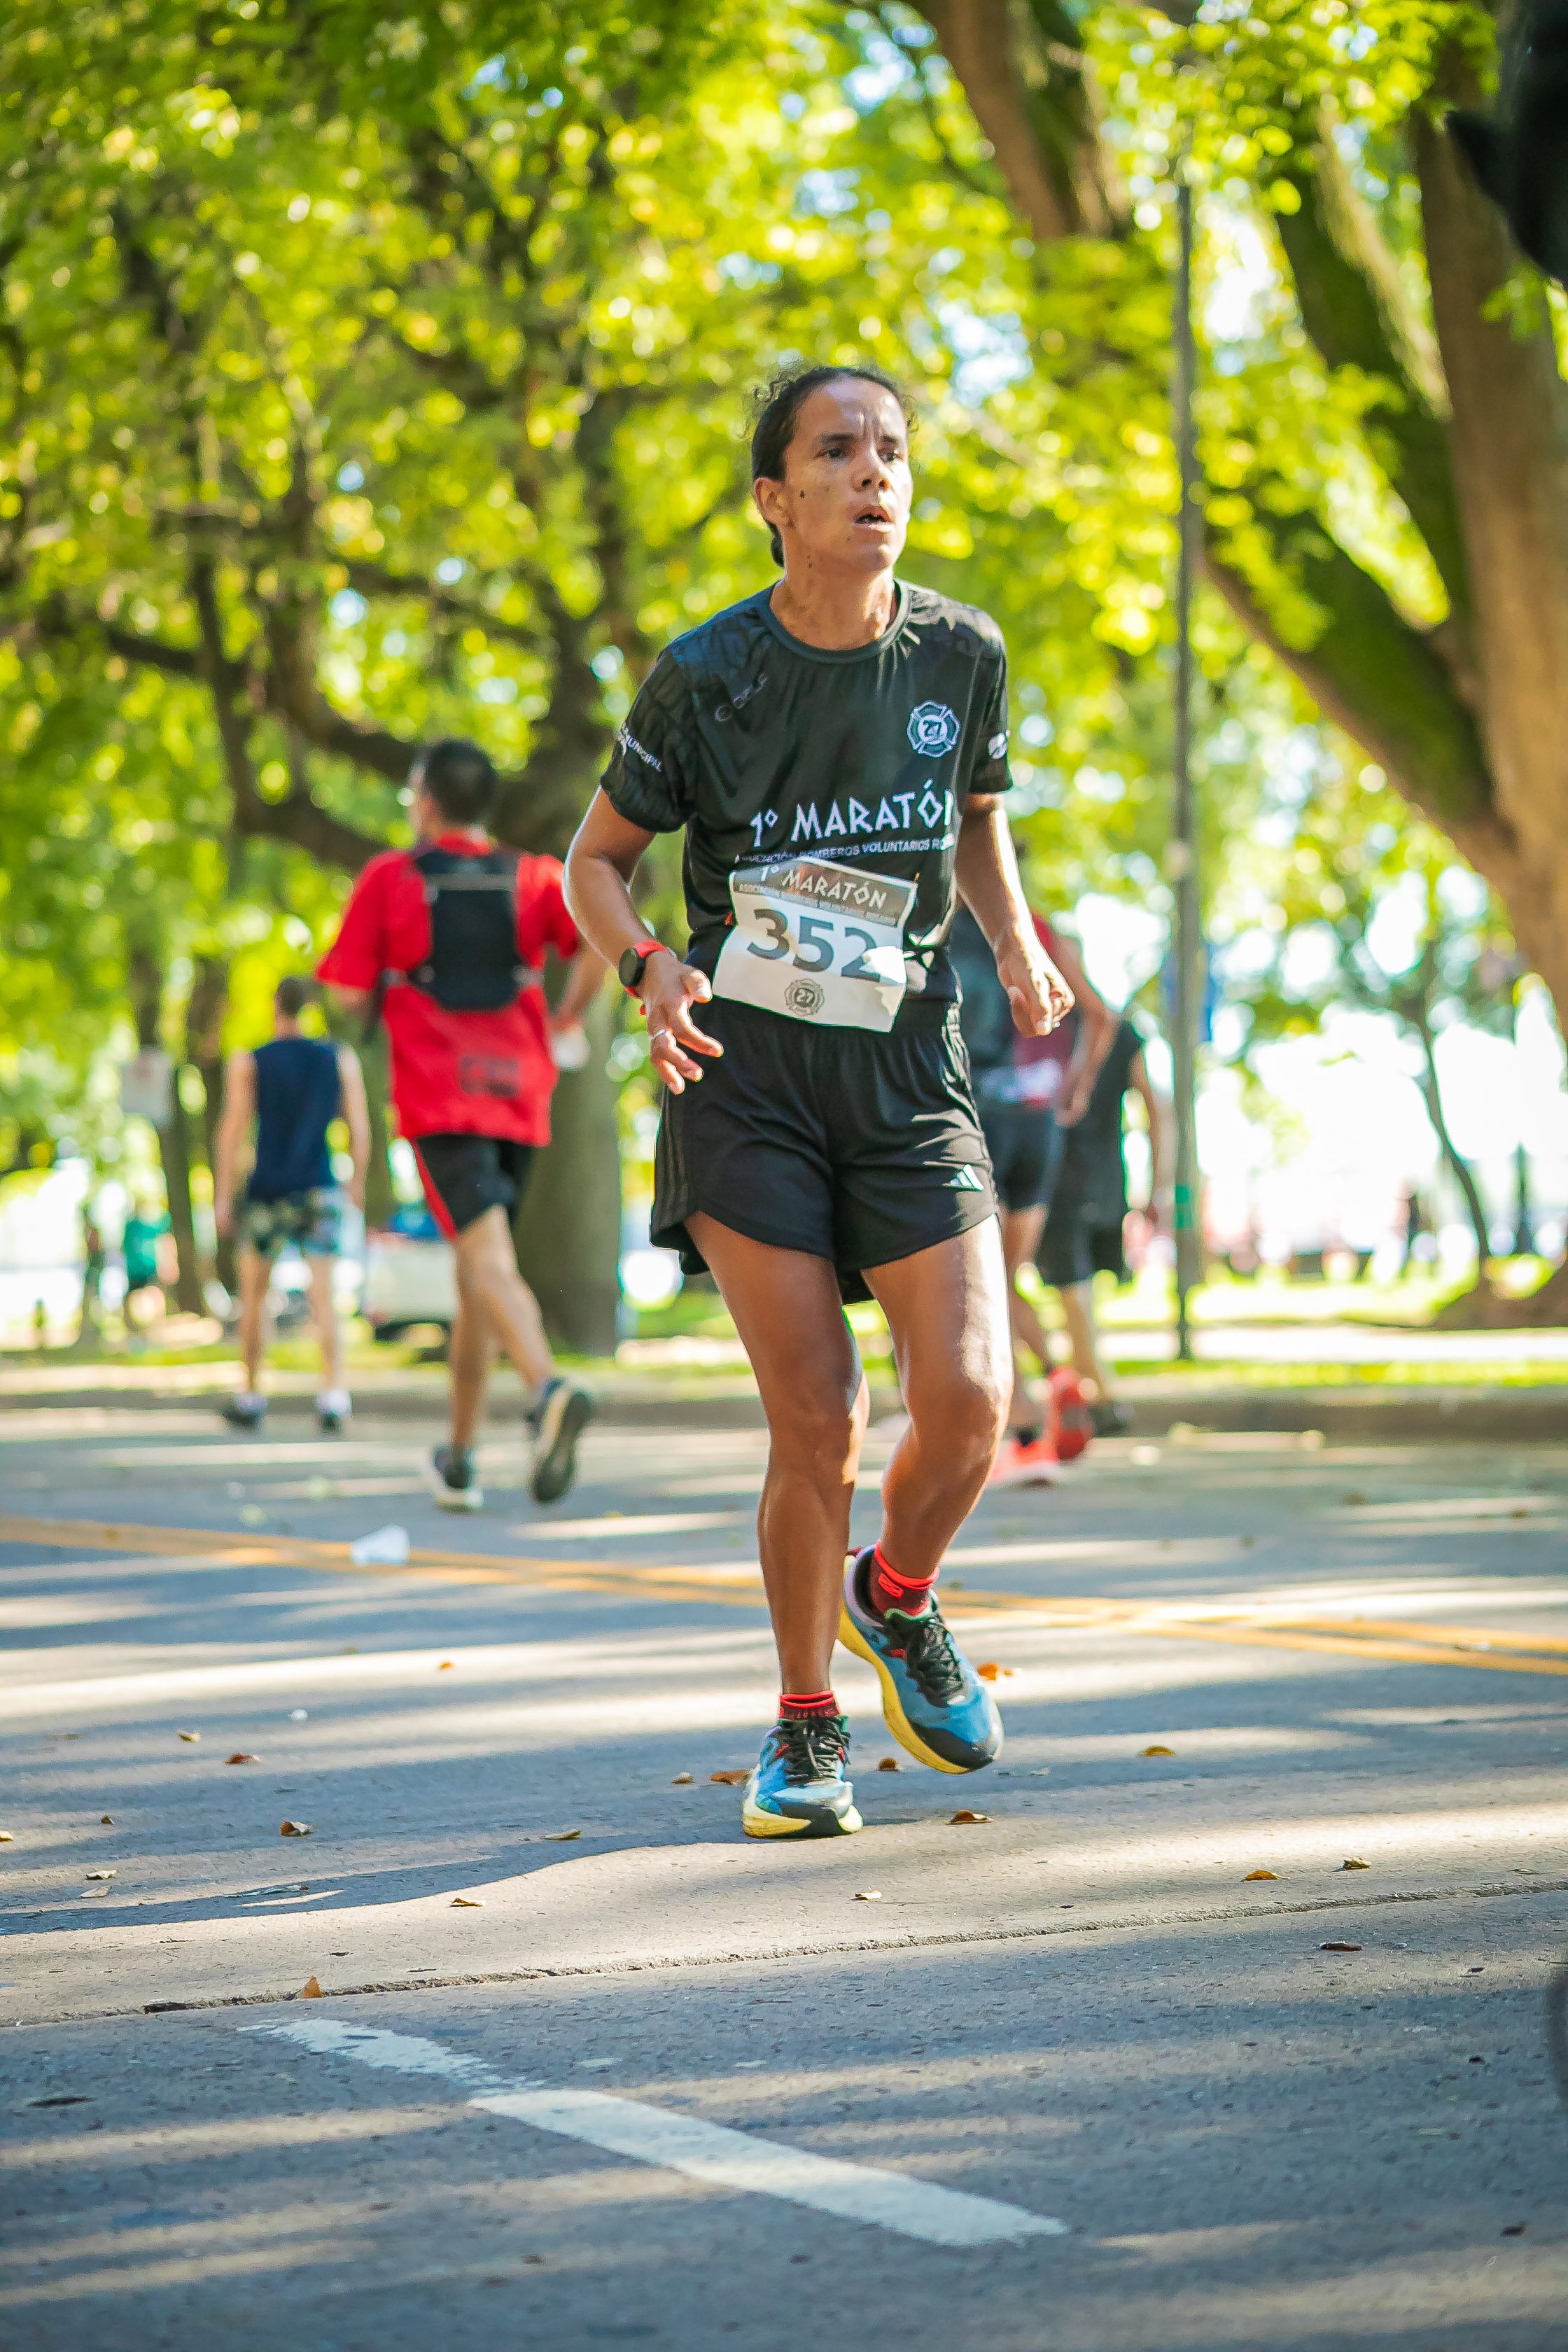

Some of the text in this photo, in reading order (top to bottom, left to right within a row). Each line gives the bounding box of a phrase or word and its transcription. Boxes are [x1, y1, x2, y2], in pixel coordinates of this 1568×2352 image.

[922, 720, 942, 737] 27
[781, 868, 888, 909] MARATÓN
[747, 908, 882, 983] 352
[796, 988, 814, 1004] 27
